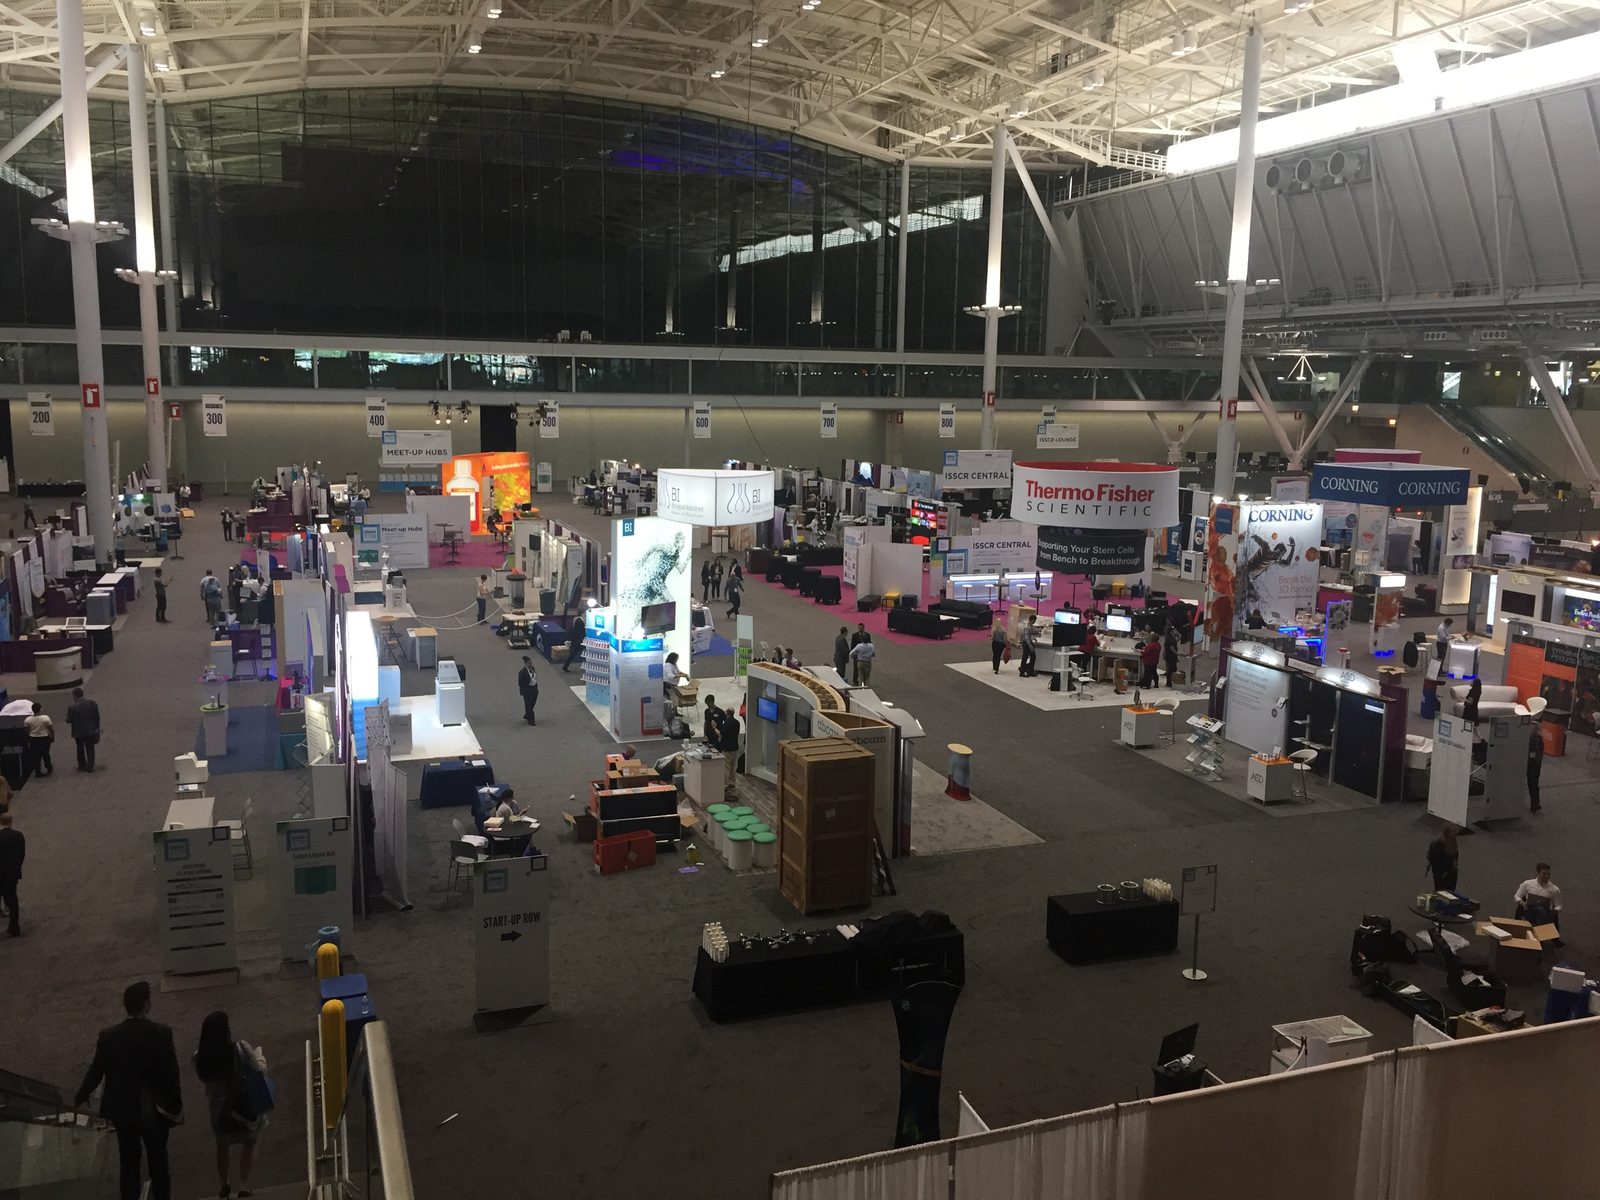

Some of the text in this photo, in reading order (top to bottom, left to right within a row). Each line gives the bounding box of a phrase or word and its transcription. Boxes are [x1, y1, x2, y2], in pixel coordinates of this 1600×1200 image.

[33, 411, 50, 424] 200
[207, 412, 223, 425] 300
[369, 414, 385, 426] 400
[543, 416, 557, 427] 500
[696, 417, 709, 428] 600
[823, 417, 835, 428] 700
[942, 418, 953, 428] 800
[945, 472, 1009, 480] ISSCR CENTRAL
[1026, 480, 1155, 502] Thermo Fisher
[1320, 476, 1379, 494] CORNING
[1398, 481, 1461, 496] CORNING
[671, 487, 681, 502] BI
[752, 488, 761, 504] BI
[1026, 500, 1152, 517] SCIENTIFIC
[1249, 508, 1314, 523] CORNING
[624, 522, 633, 533] BI
[972, 541, 1031, 550] ISSCR CENTRAL
[1070, 544, 1091, 554] Your
[1092, 546, 1115, 554] Stem
[1117, 546, 1135, 554] Cells
[1040, 551, 1141, 567] from Bench to Breakthrough
[483, 911, 541, 928] START-UP ROW
